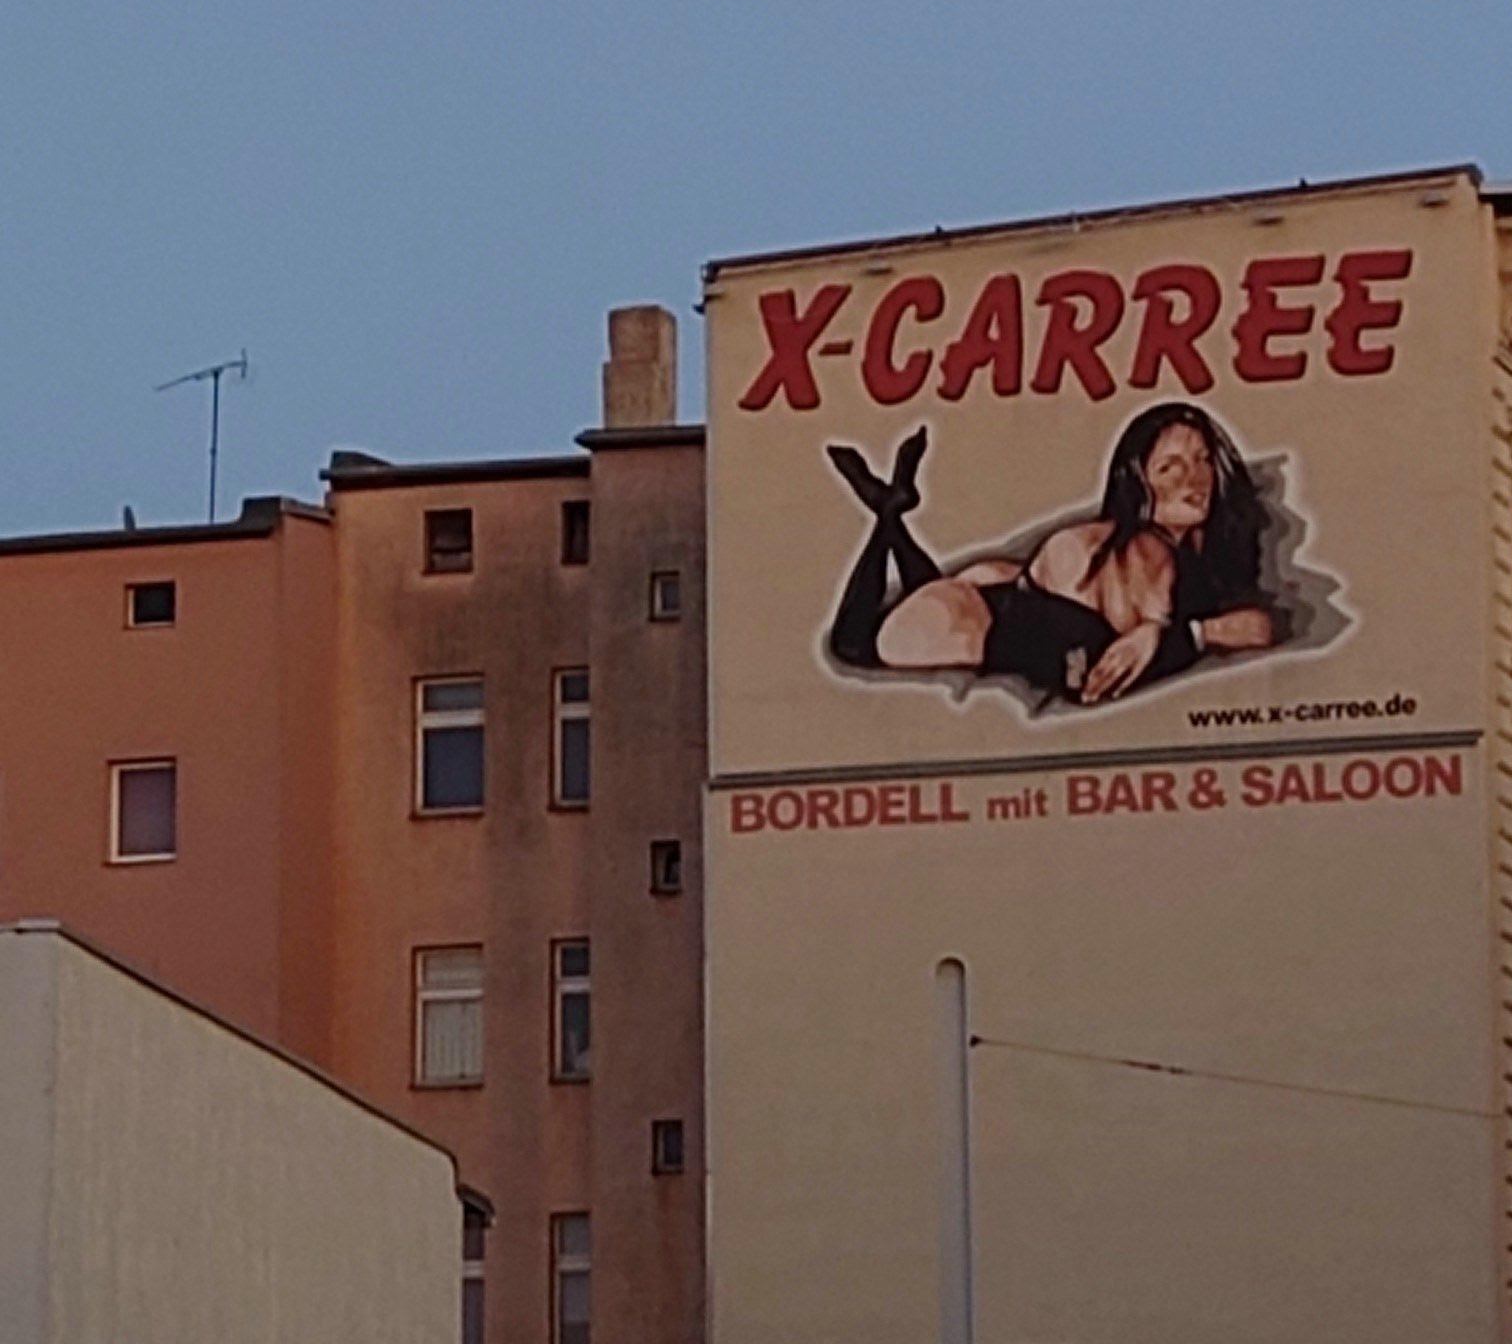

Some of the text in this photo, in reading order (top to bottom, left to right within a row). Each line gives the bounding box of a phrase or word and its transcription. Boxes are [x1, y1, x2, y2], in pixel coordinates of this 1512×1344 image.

[739, 250, 1413, 411] X-CARREE
[1188, 693, 1418, 728] www.x-carree.de
[730, 755, 1462, 834] BORDELL mit BAR & SALOON
